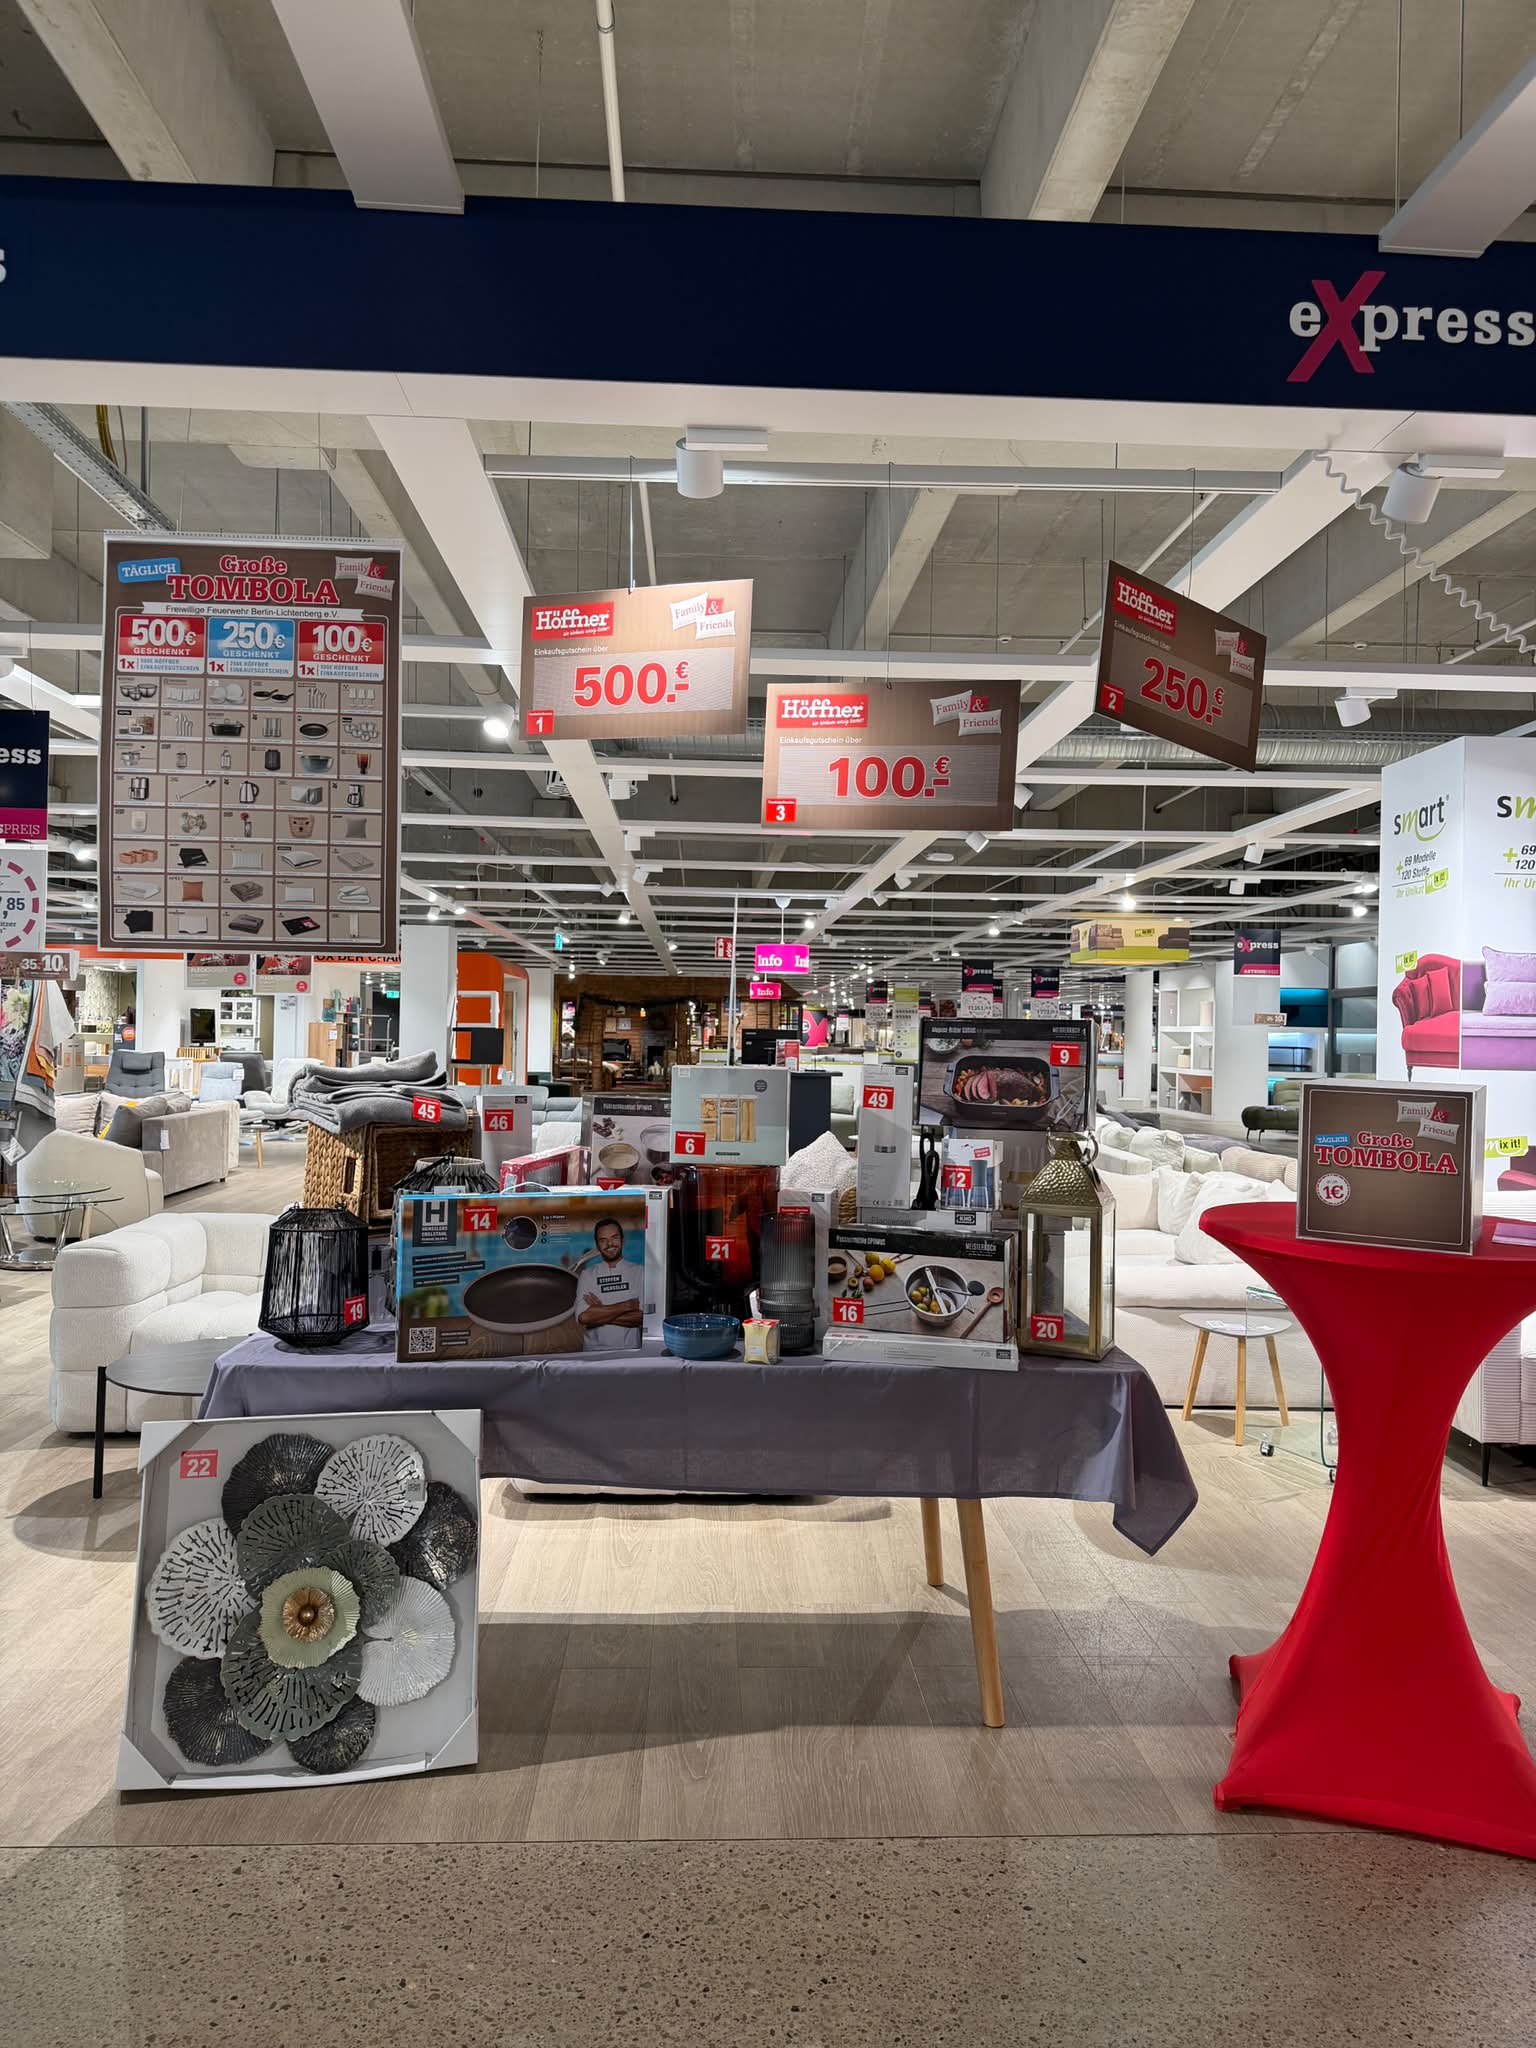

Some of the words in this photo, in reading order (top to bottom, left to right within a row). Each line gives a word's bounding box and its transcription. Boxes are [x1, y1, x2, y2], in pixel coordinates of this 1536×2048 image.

[1286, 270, 1536, 382] eXpress
[121, 561, 177, 578] TÄGLICH
[219, 554, 287, 576] Große
[339, 562, 369, 575] Family
[370, 567, 382, 577] &
[167, 574, 340, 605] TOMBOLA
[360, 580, 391, 593] Friends
[675, 601, 706, 620] Family
[707, 600, 720, 615] &
[1116, 581, 1175, 626] Höffner
[165, 605, 205, 615] Freiwillige
[206, 606, 249, 616] Feuerwehr
[250, 607, 322, 619] Berlin-Lichtenberg
[323, 610, 340, 619] e.V.
[535, 608, 610, 631] Höffner
[131, 618, 197, 648] 500€
[699, 618, 733, 632] Friends
[222, 621, 286, 650] 250€
[312, 624, 373, 654] 100€
[133, 647, 191, 656] GESCHENKT
[222, 649, 281, 659] GESCHENKT
[312, 653, 371, 663] GESCHENKT
[534, 647, 592, 657] Einkaufsgutschein
[593, 645, 609, 653] über
[119, 658, 135, 670] 1x
[208, 660, 225, 672] 1x
[299, 664, 315, 676] 1x
[781, 698, 864, 719] Höffner
[936, 698, 969, 715] Family
[972, 698, 985, 712] &
[1108, 692, 1117, 711] 2
[536, 717, 544, 733] 1
[963, 717, 999, 728] Friends
[779, 736, 844, 745] Einkaufsgutschein
[845, 736, 863, 744] über
[775, 804, 786, 822] 3
[1393, 796, 1447, 842] smart
[1520, 844, 1536, 856] 69
[1514, 859, 1536, 870] 120
[1503, 877, 1521, 889] Ihr
[1236, 935, 1280, 953] eXpress
[757, 953, 783, 967] Info
[757, 988, 775, 996] Info
[1059, 1049, 1070, 1064] 9
[867, 1091, 889, 1109] 49
[417, 1103, 437, 1120] 45
[1401, 1105, 1433, 1118] Family
[1433, 1111, 1446, 1122] &
[488, 1115, 509, 1131] 46
[1422, 1123, 1456, 1138] Friends
[684, 1139, 696, 1154] 6
[1316, 1135, 1349, 1144] TÄGLICH
[1357, 1131, 1414, 1149] Große
[1314, 1144, 1458, 1175] TOMBOLA
[949, 1172, 967, 1188] 12
[1322, 1184, 1345, 1200] 1€
[470, 1212, 491, 1231] 14
[710, 1243, 730, 1260] 21
[349, 1302, 363, 1322] 19
[839, 1304, 858, 1322] 16
[1035, 1320, 1058, 1339] 20
[186, 1457, 211, 1478] 22
